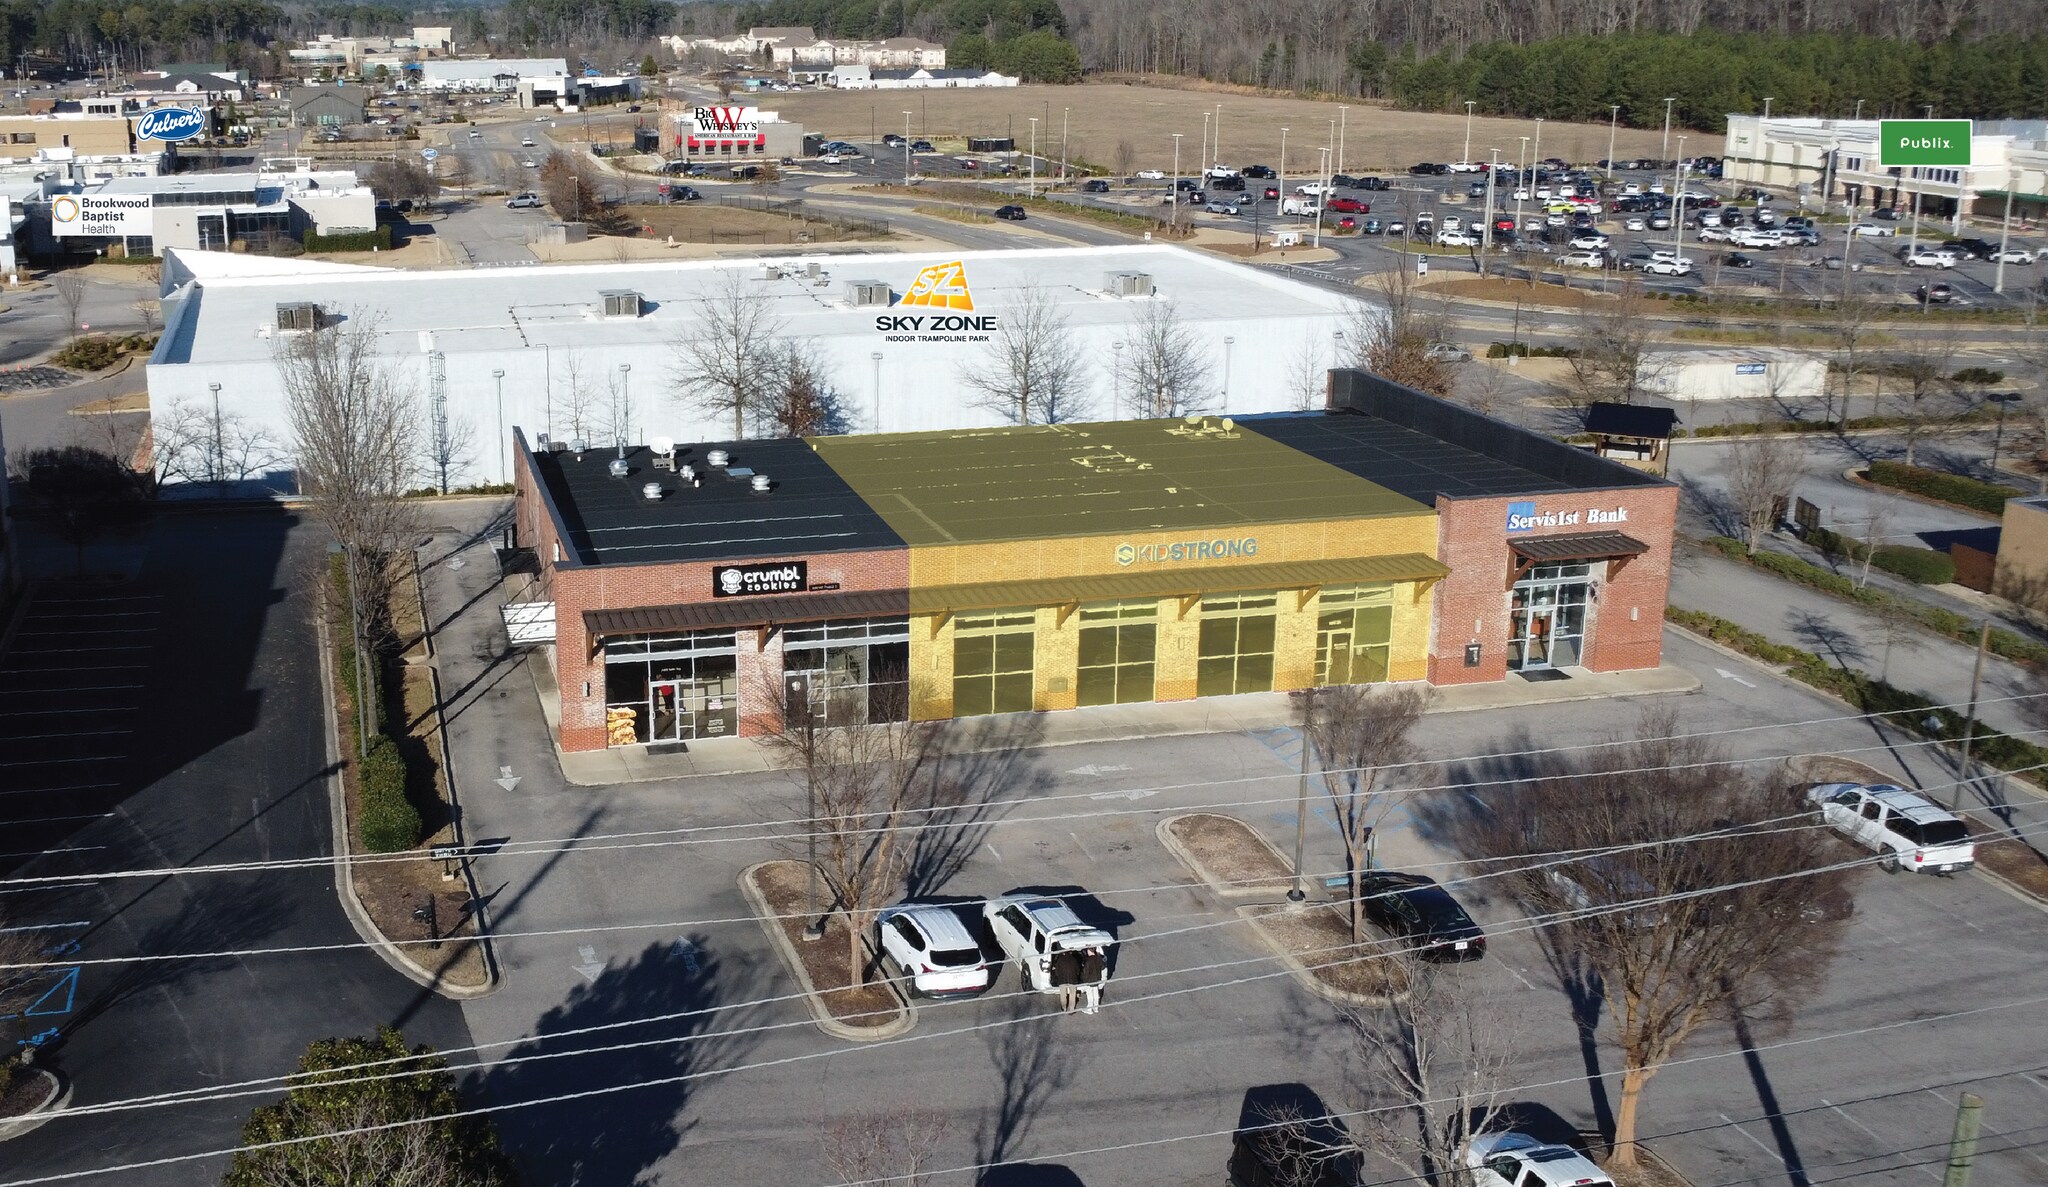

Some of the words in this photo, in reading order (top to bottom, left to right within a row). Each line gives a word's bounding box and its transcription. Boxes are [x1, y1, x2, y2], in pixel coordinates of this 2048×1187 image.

[1507, 510, 1580, 529] Servis1st
[1586, 506, 1628, 524] Bank
[1137, 537, 1258, 563] KIDSTRONG
[743, 566, 801, 583] crumbl
[747, 580, 797, 592] cookies
